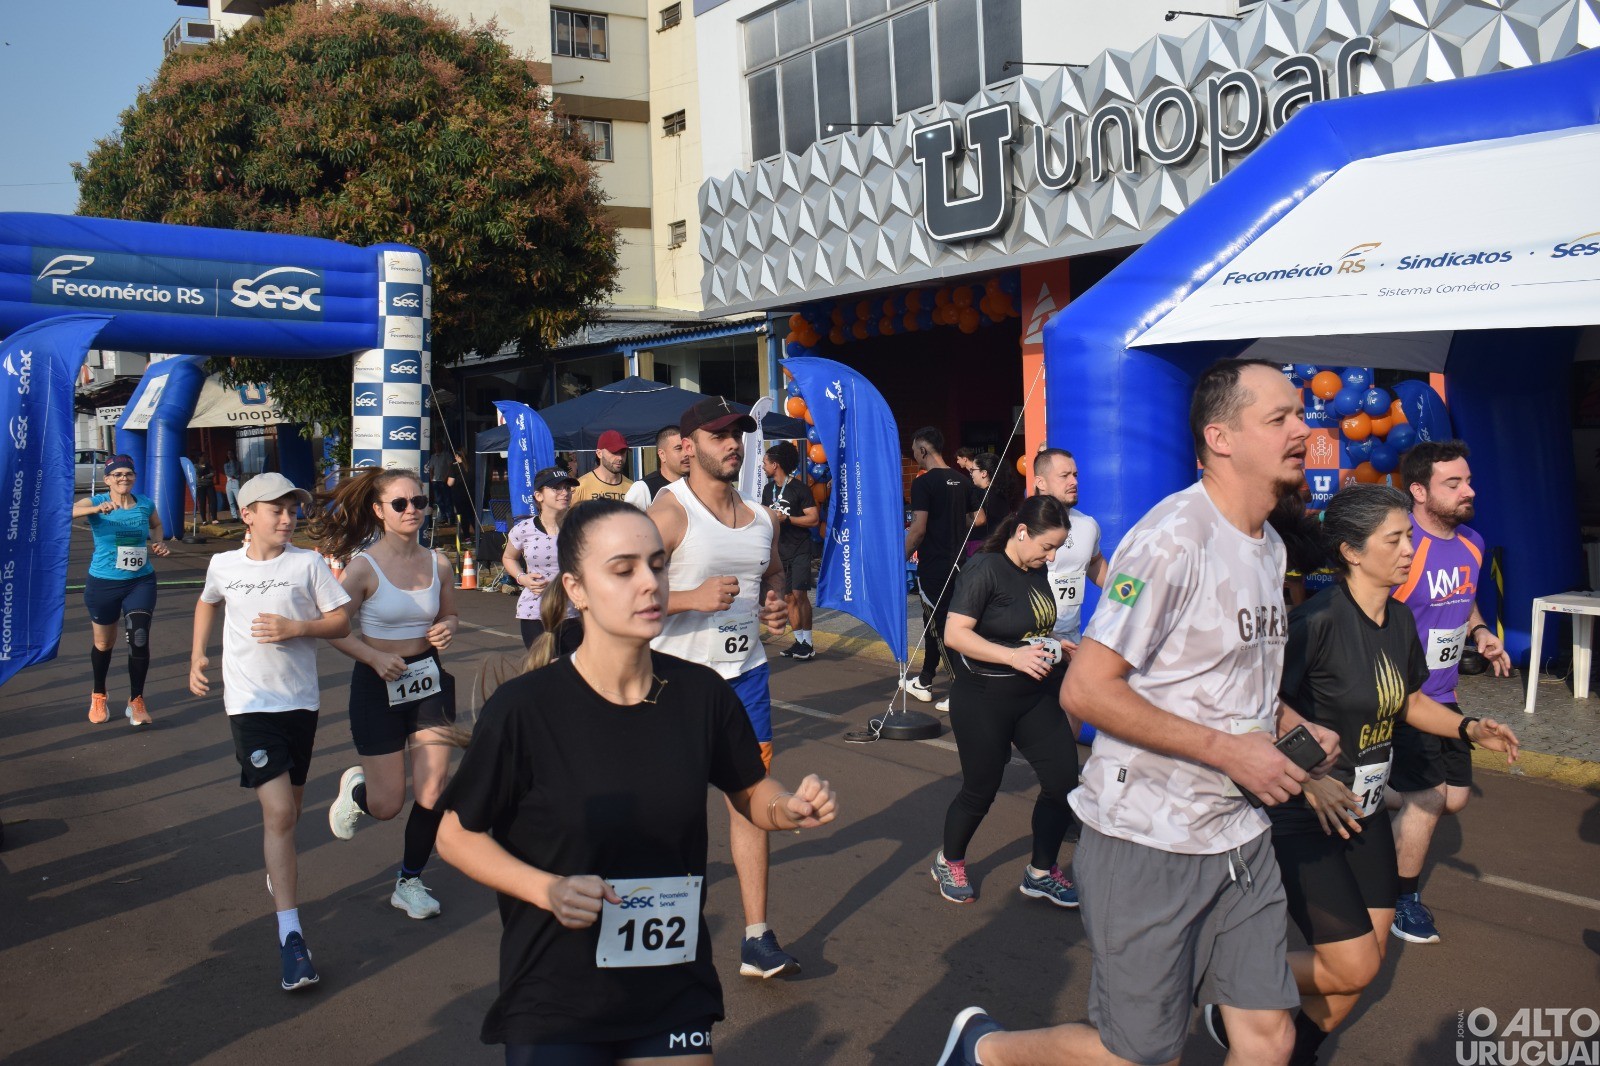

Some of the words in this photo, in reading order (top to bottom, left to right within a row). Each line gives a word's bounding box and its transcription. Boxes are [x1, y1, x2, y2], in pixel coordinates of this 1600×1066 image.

[1034, 35, 1383, 190] unopar
[1223, 263, 1333, 286] Fecomércio
[1337, 259, 1366, 275] RS
[1397, 251, 1513, 270] Sindicatos
[1550, 243, 1600, 258] Ses
[52, 278, 171, 303] Fecomércio
[177, 287, 205, 305] RS
[231, 278, 321, 311] Sesc
[1378, 286, 1432, 297] Sistema
[1435, 282, 1500, 294] Comércio
[393, 297, 419, 308] Sesc
[18, 350, 32, 395] Senac
[390, 363, 418, 374] Sesc
[356, 396, 377, 406] Sesc
[15, 416, 28, 450] Sesc
[389, 431, 417, 440] Sesc
[32, 469, 43, 507] Comércio
[840, 463, 849, 514] Sindicatos
[7, 470, 24, 540] Sindicatos
[29, 507, 39, 543] Sistema
[841, 528, 850, 543] RS
[4, 560, 15, 579] RS
[123, 557, 143, 567] 196
[841, 544, 852, 602] Fecomércio
[1059, 587, 1076, 600] 79
[1427, 566, 1476, 599] KM7
[1, 582, 13, 661] Fecomércio
[719, 625, 738, 633] Sesc
[725, 635, 749, 654] 62
[1440, 645, 1459, 662] 82
[396, 677, 433, 698] 140
[620, 896, 655, 909] Sesc
[618, 916, 686, 951] 162
